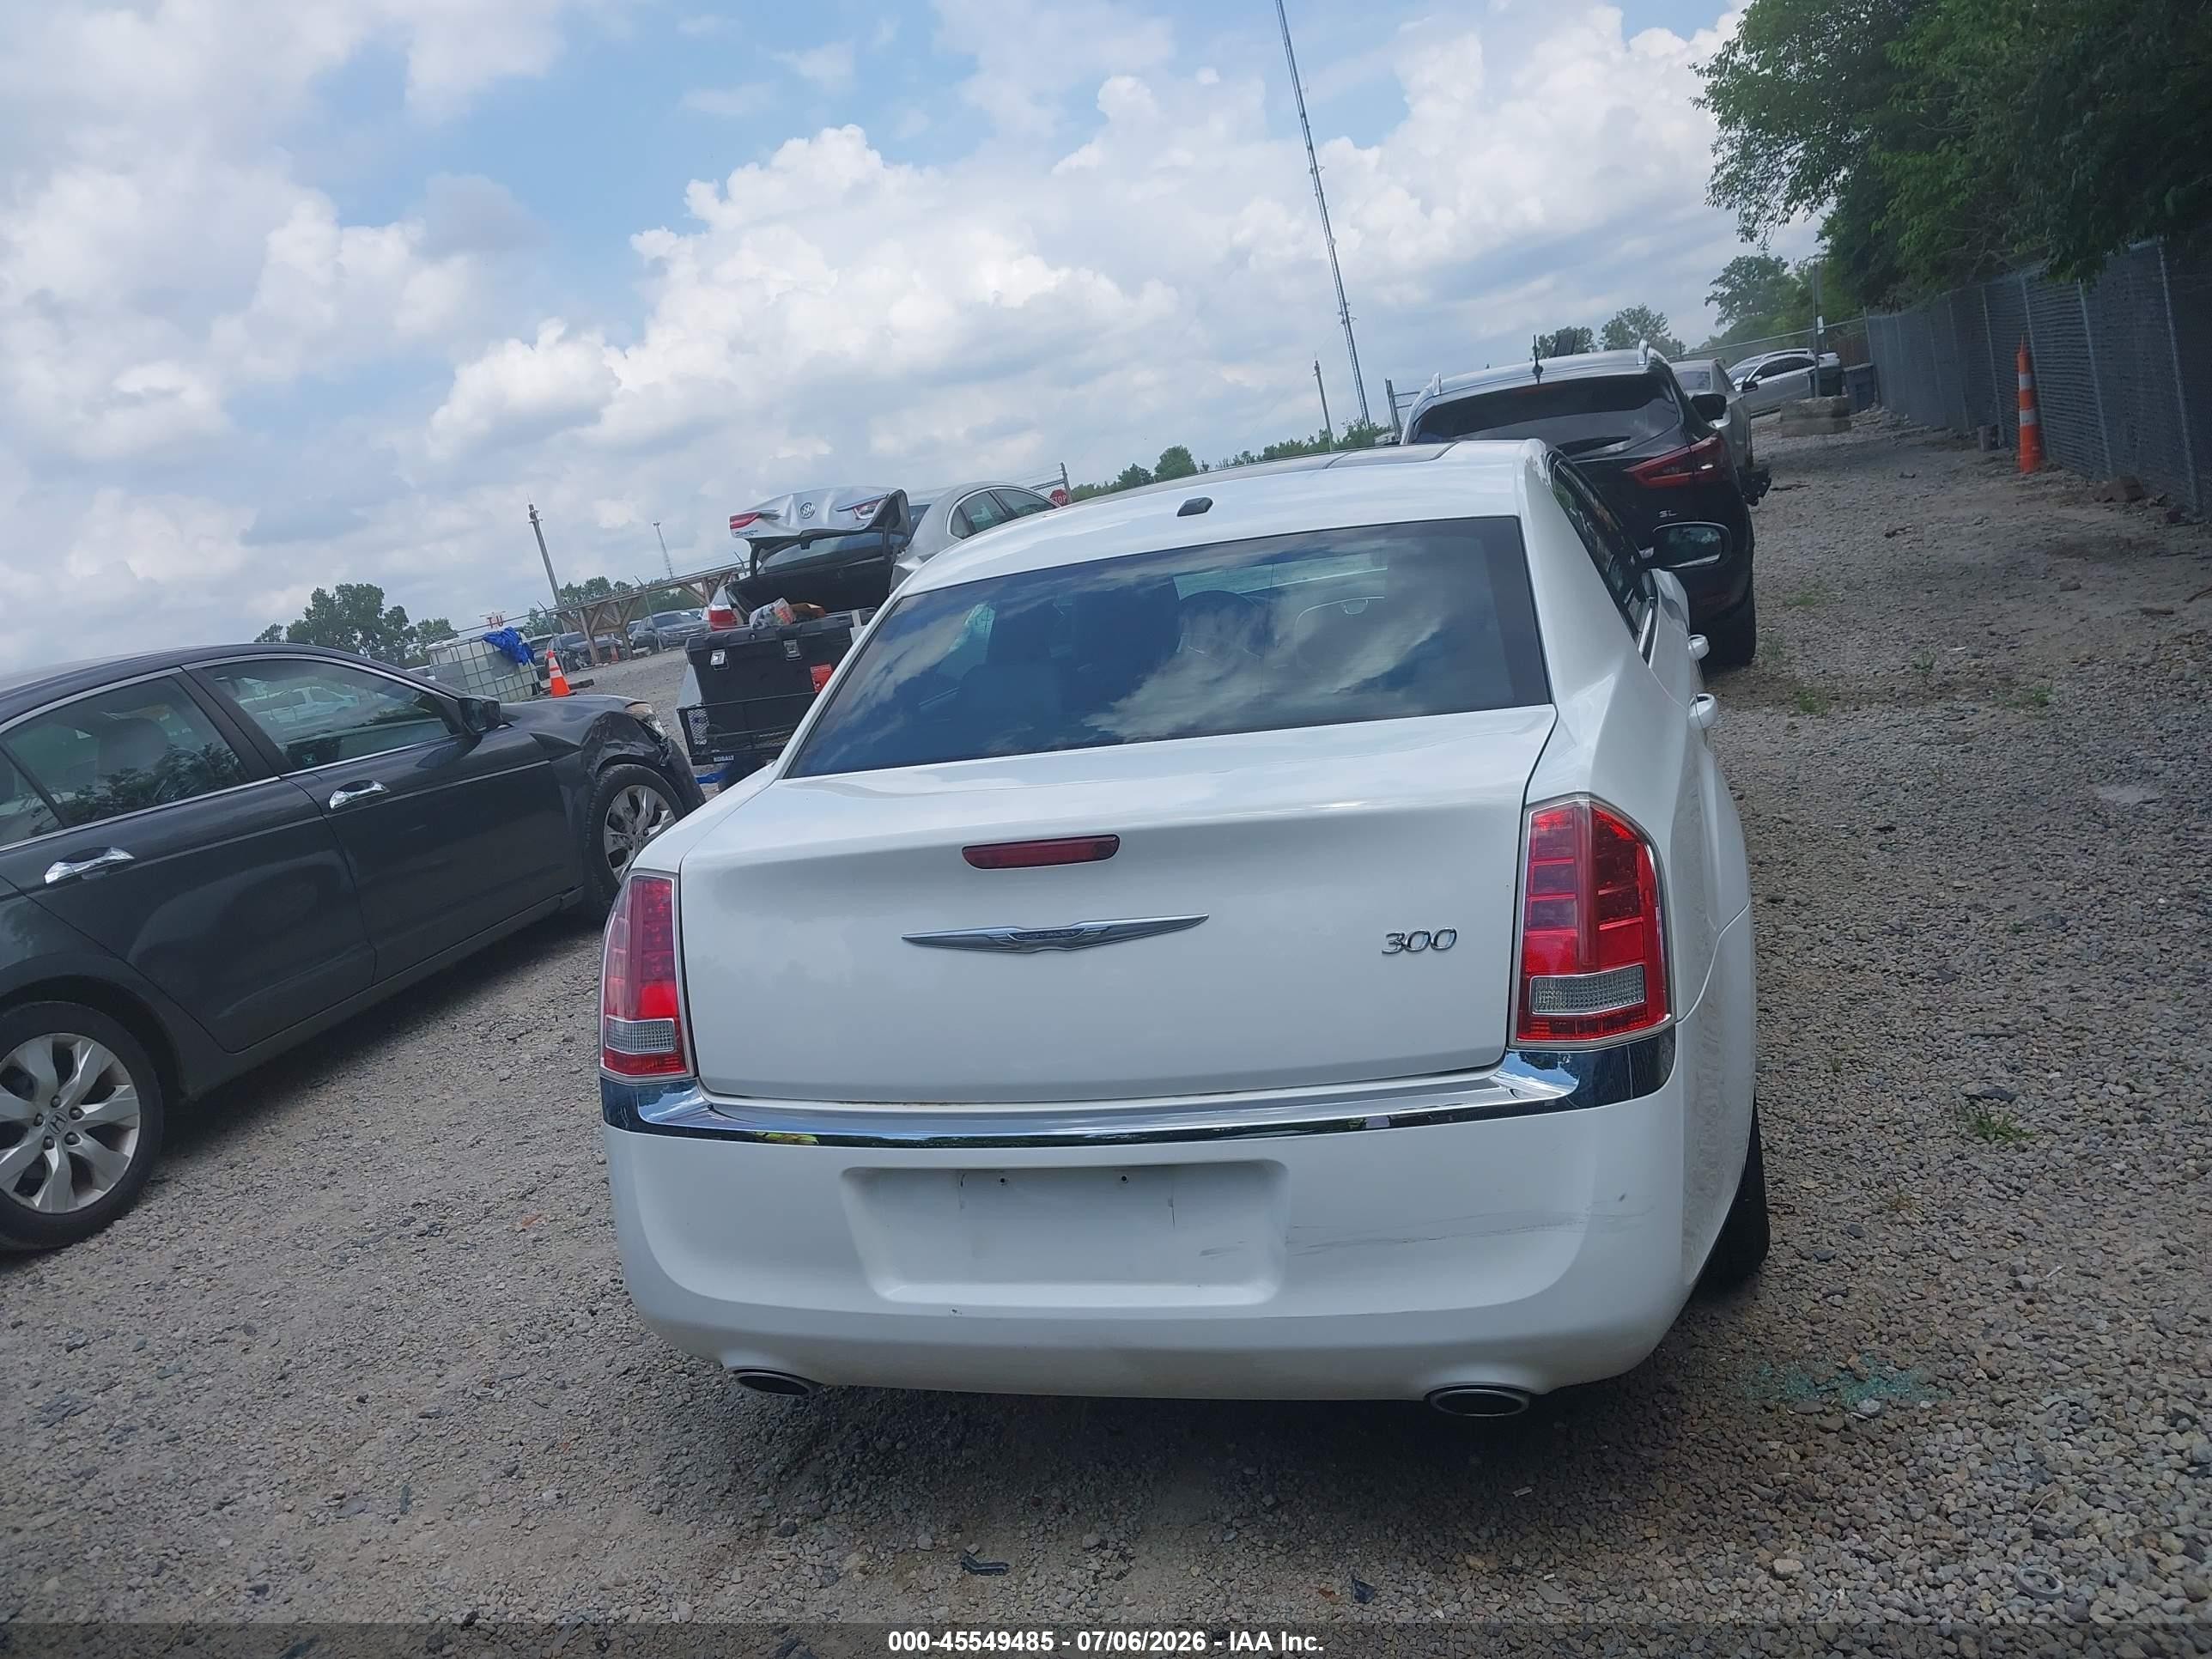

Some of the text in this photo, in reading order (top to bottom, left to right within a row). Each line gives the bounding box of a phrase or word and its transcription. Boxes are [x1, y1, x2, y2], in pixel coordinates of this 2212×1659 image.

[1052, 495, 1067, 503] TOP
[1659, 509, 1678, 518] SL
[1381, 926, 1458, 955] 300
